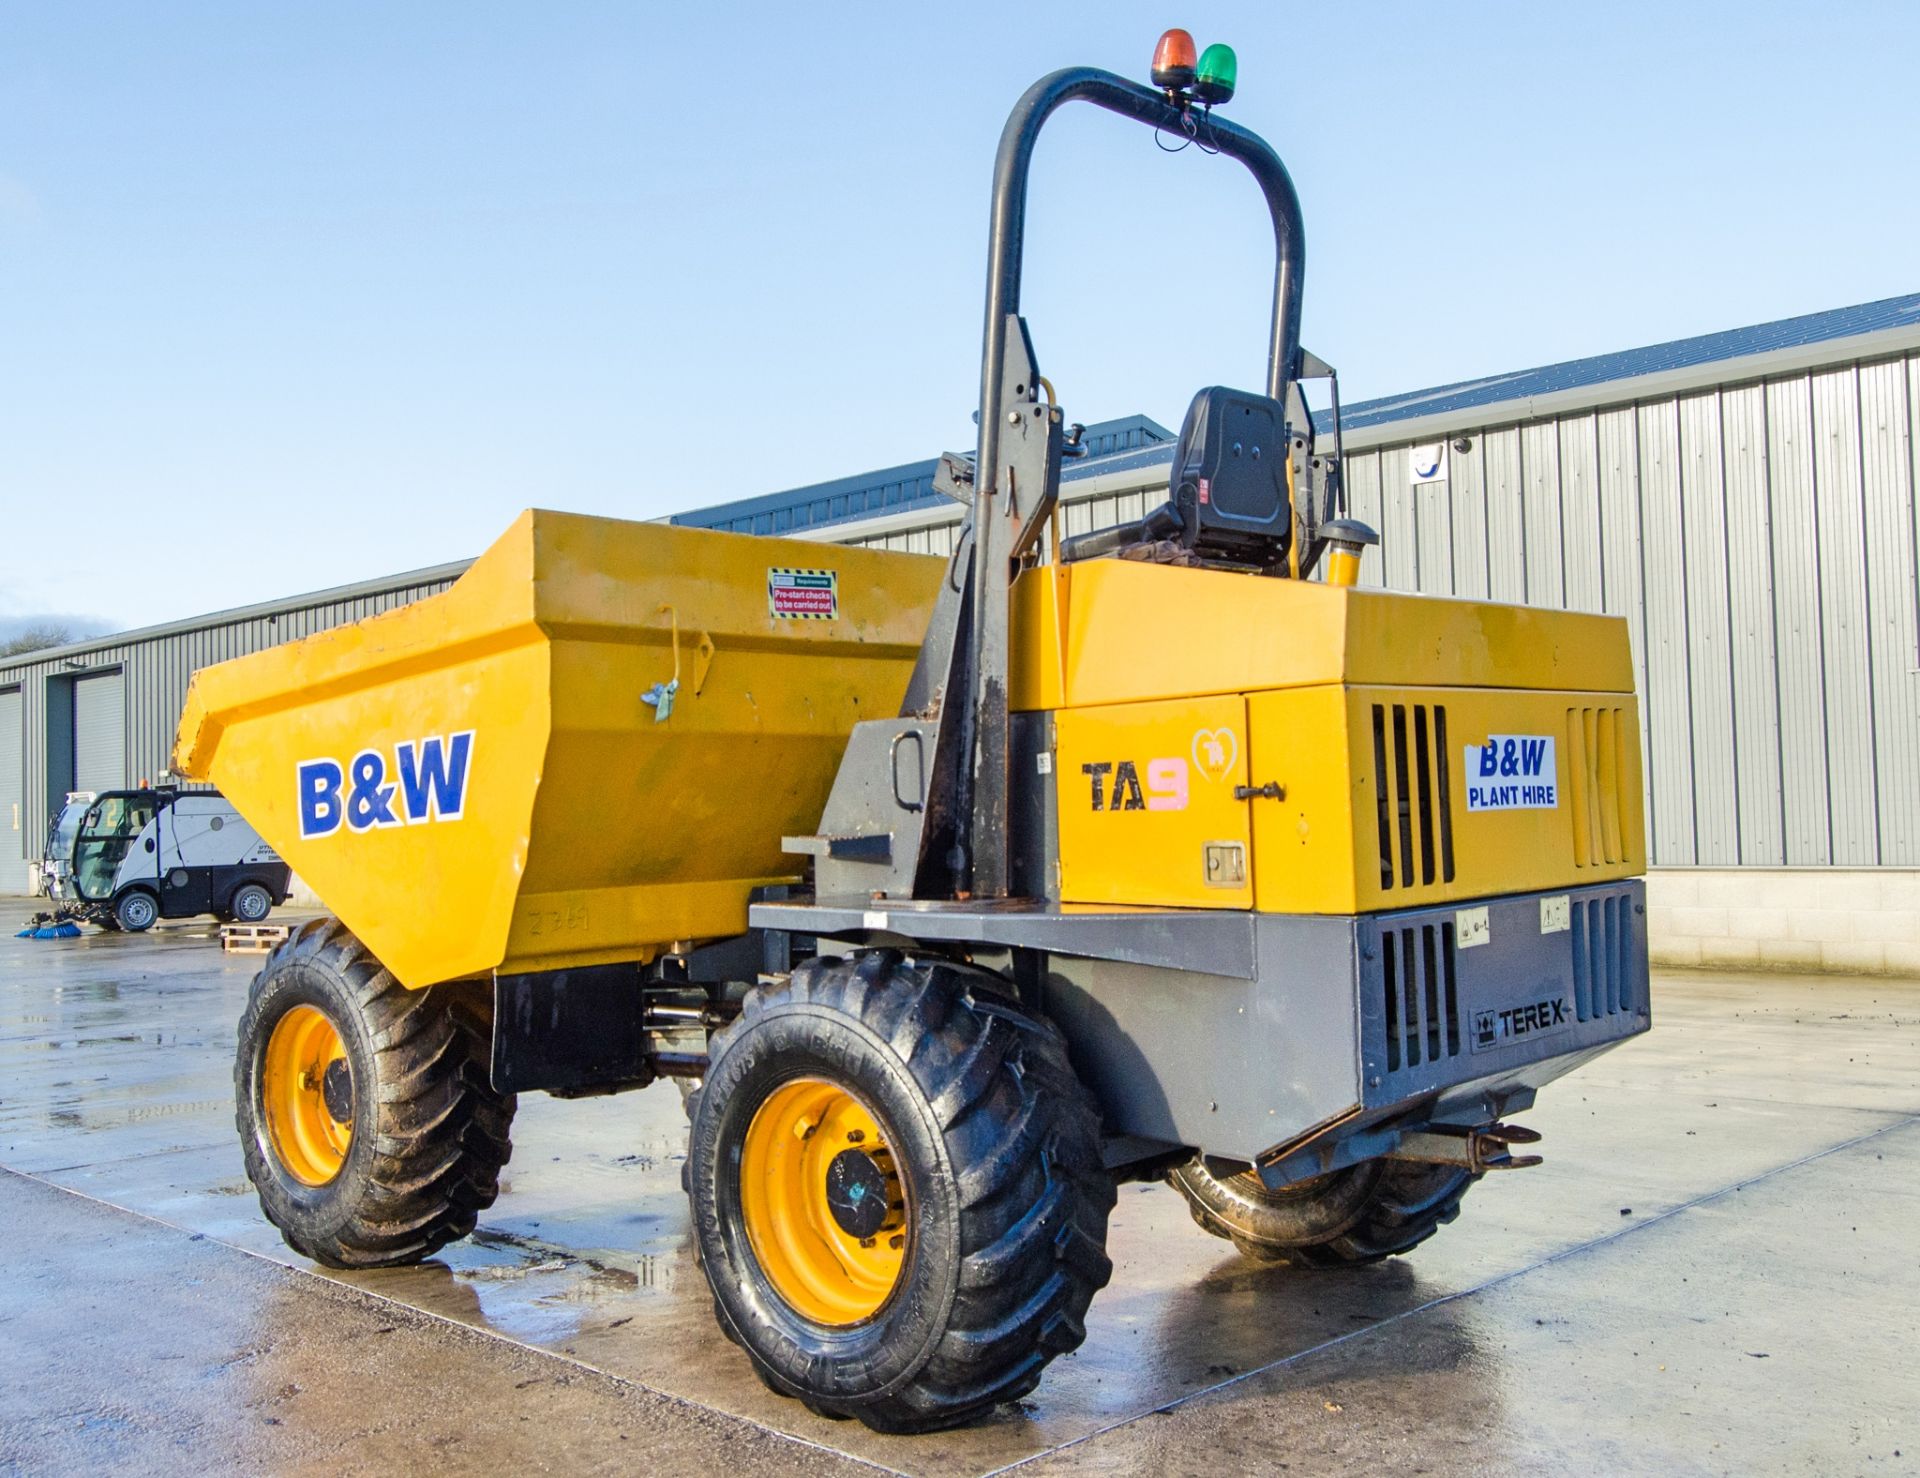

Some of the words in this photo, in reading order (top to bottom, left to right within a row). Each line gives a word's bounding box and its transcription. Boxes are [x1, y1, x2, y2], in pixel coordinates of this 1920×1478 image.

[775, 590, 804, 599] Pre-start
[1480, 739, 1546, 777] B&W
[298, 731, 475, 838] B&W
[1082, 757, 1189, 811] TA9
[1470, 786, 1518, 807] PLANT
[1522, 786, 1554, 804] HIRE
[12, 803, 18, 830] 1
[1499, 999, 1565, 1036] TEREX
